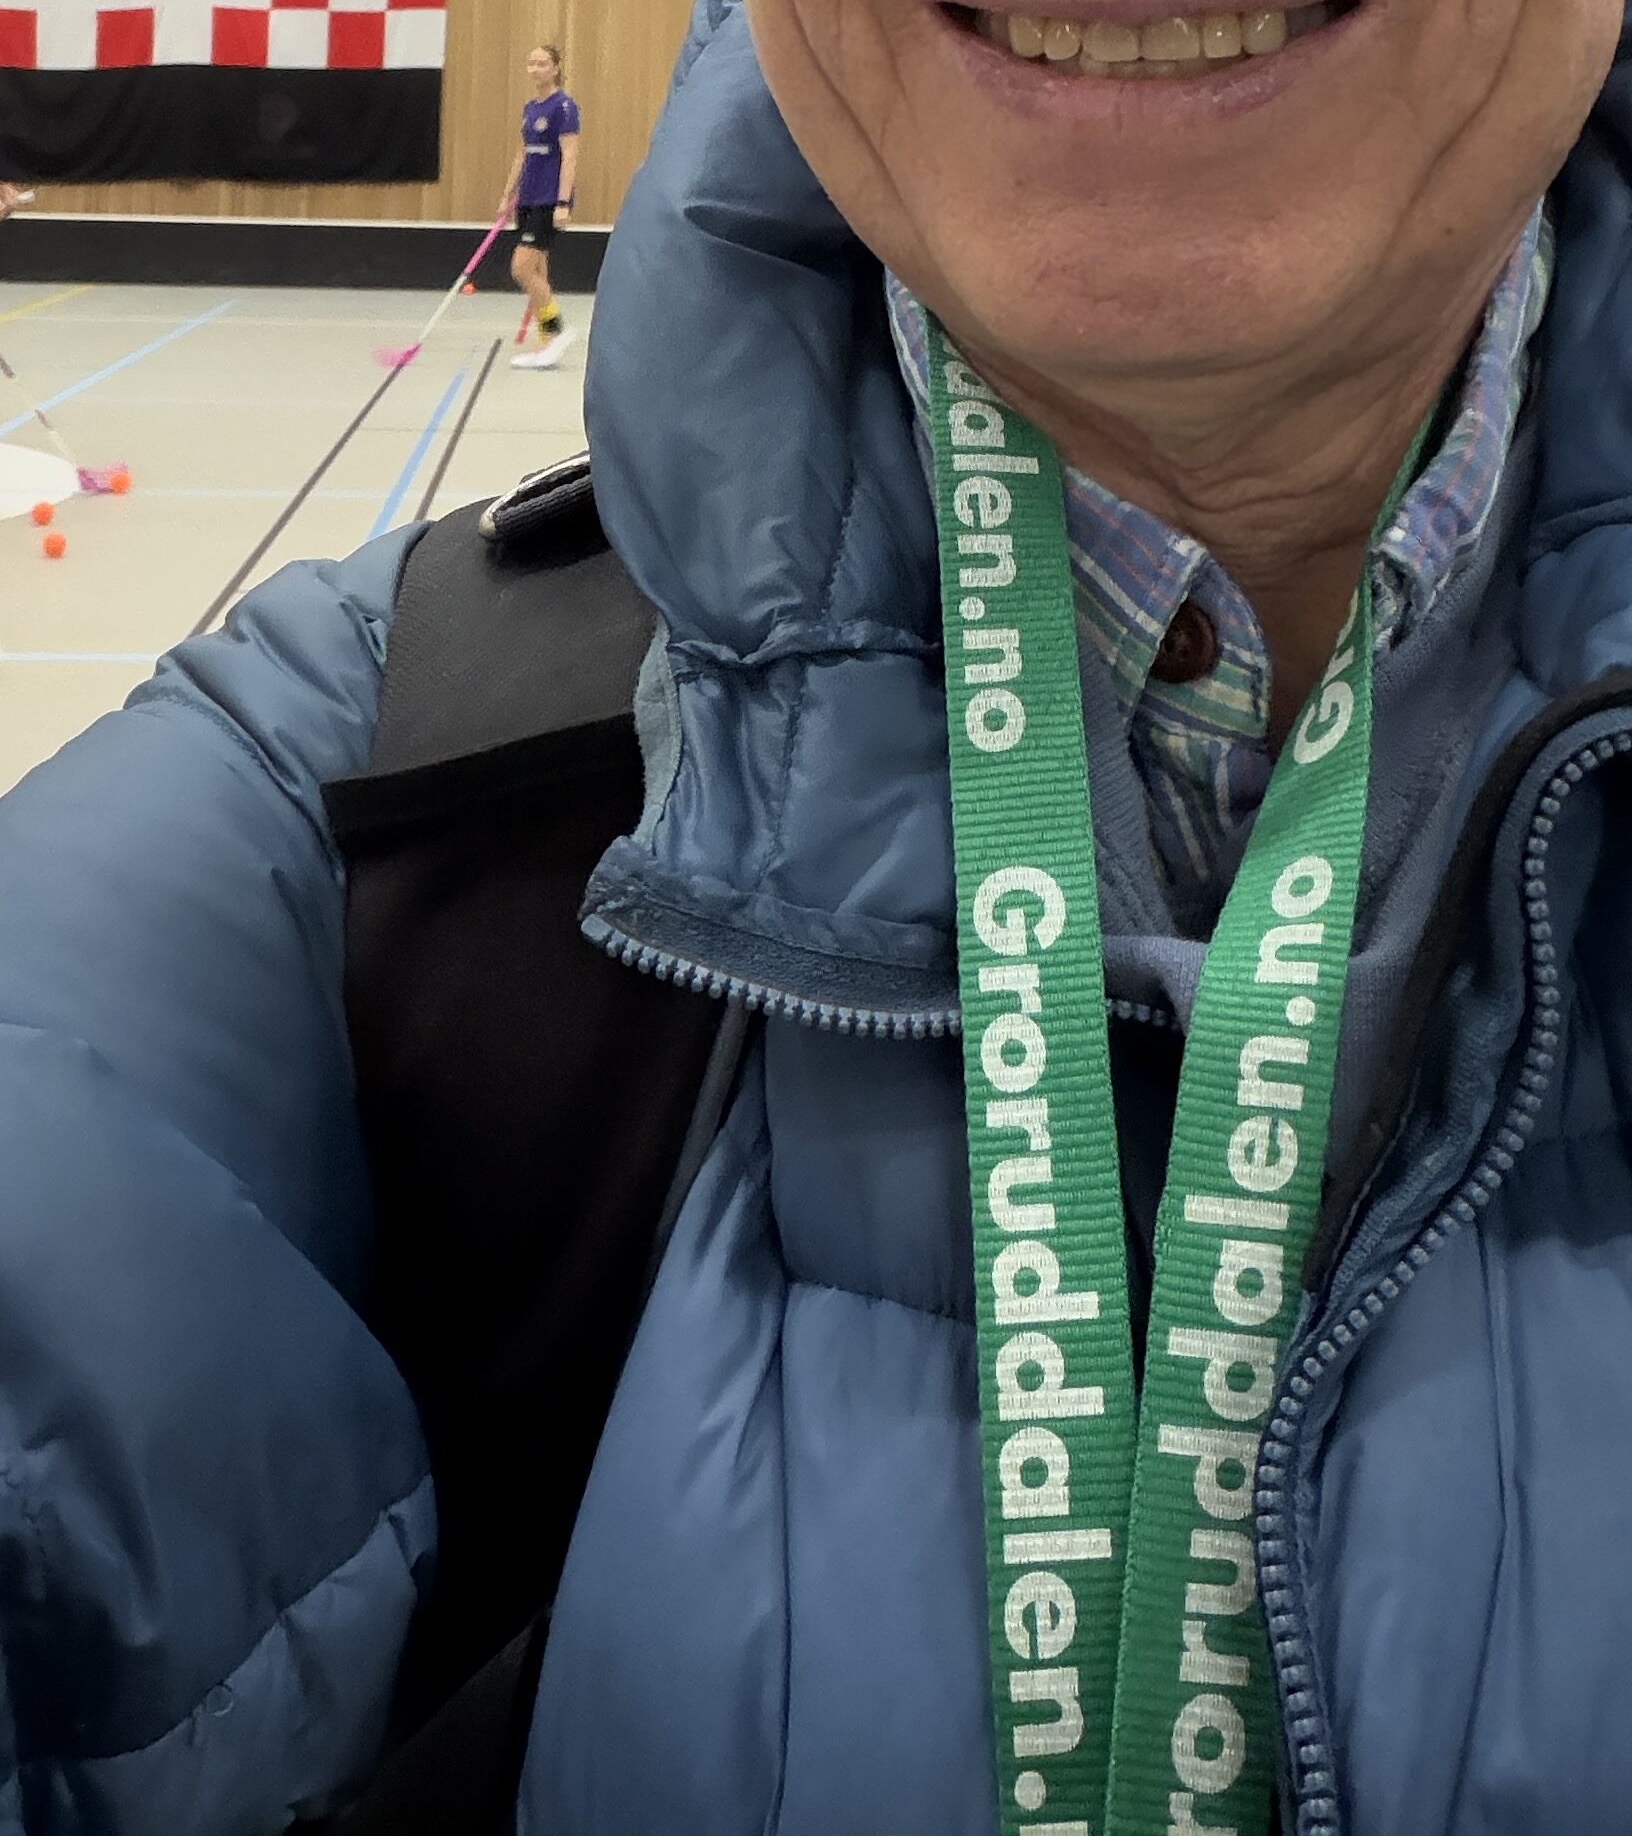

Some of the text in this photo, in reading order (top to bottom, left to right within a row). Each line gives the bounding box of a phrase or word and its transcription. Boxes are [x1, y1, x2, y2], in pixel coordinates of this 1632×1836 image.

[942, 332, 1112, 1836] dalen.no Groruddalen.
[1293, 587, 1360, 765] Gr
